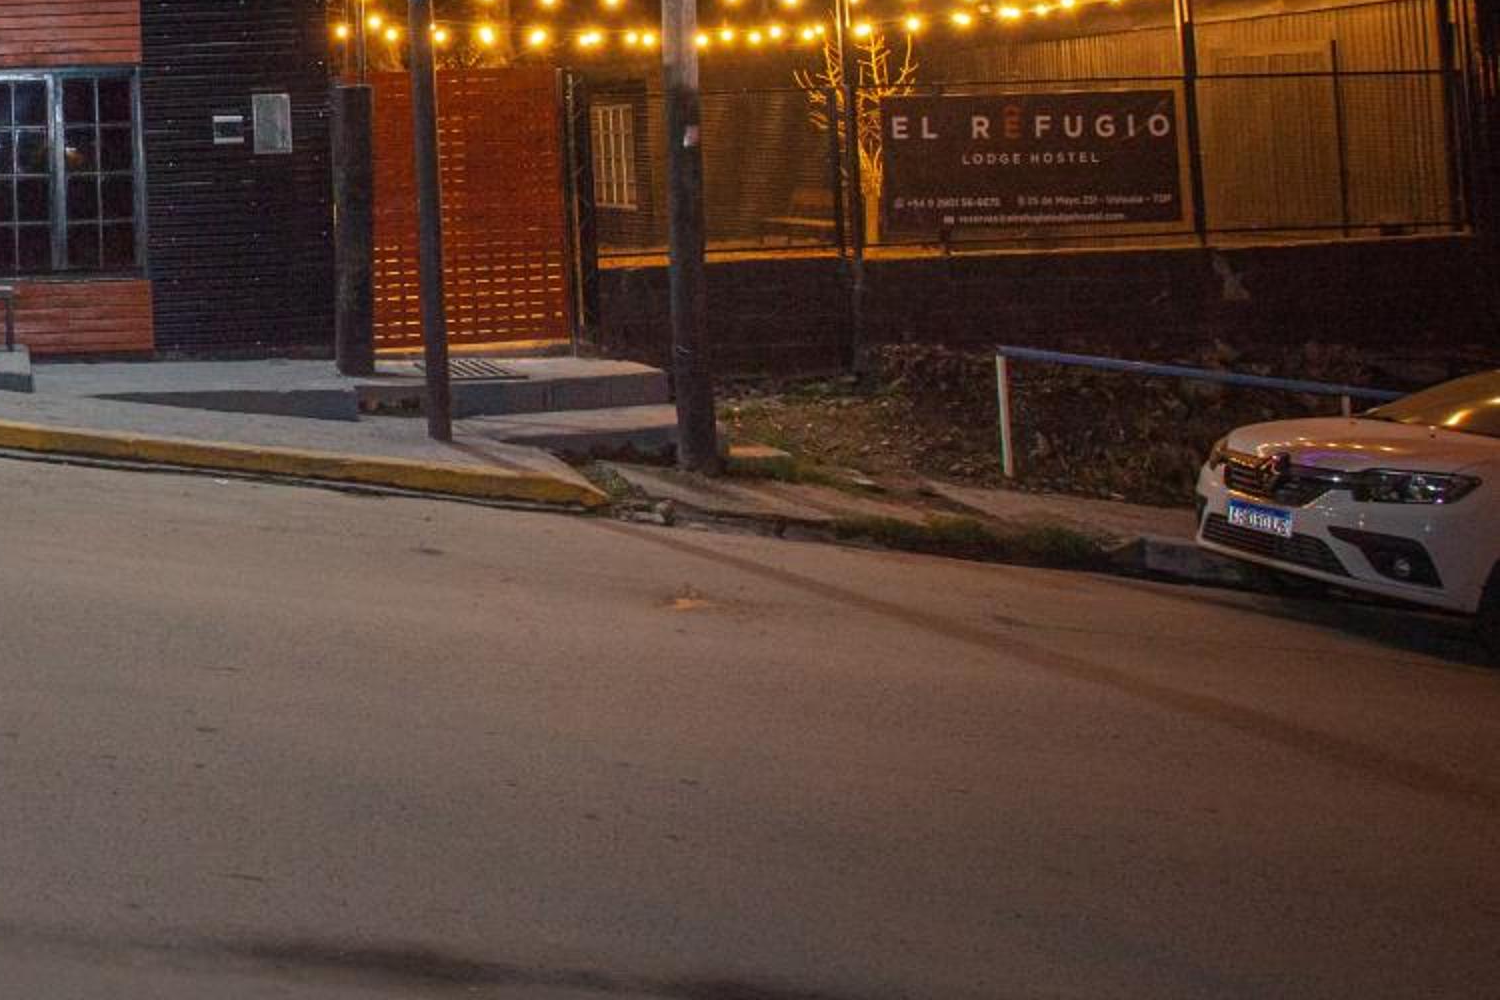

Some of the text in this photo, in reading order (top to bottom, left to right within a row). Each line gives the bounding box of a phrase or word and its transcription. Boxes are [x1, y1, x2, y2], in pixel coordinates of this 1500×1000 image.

[891, 115, 939, 140] EL
[961, 150, 1100, 166] LODGE HOSTEL
